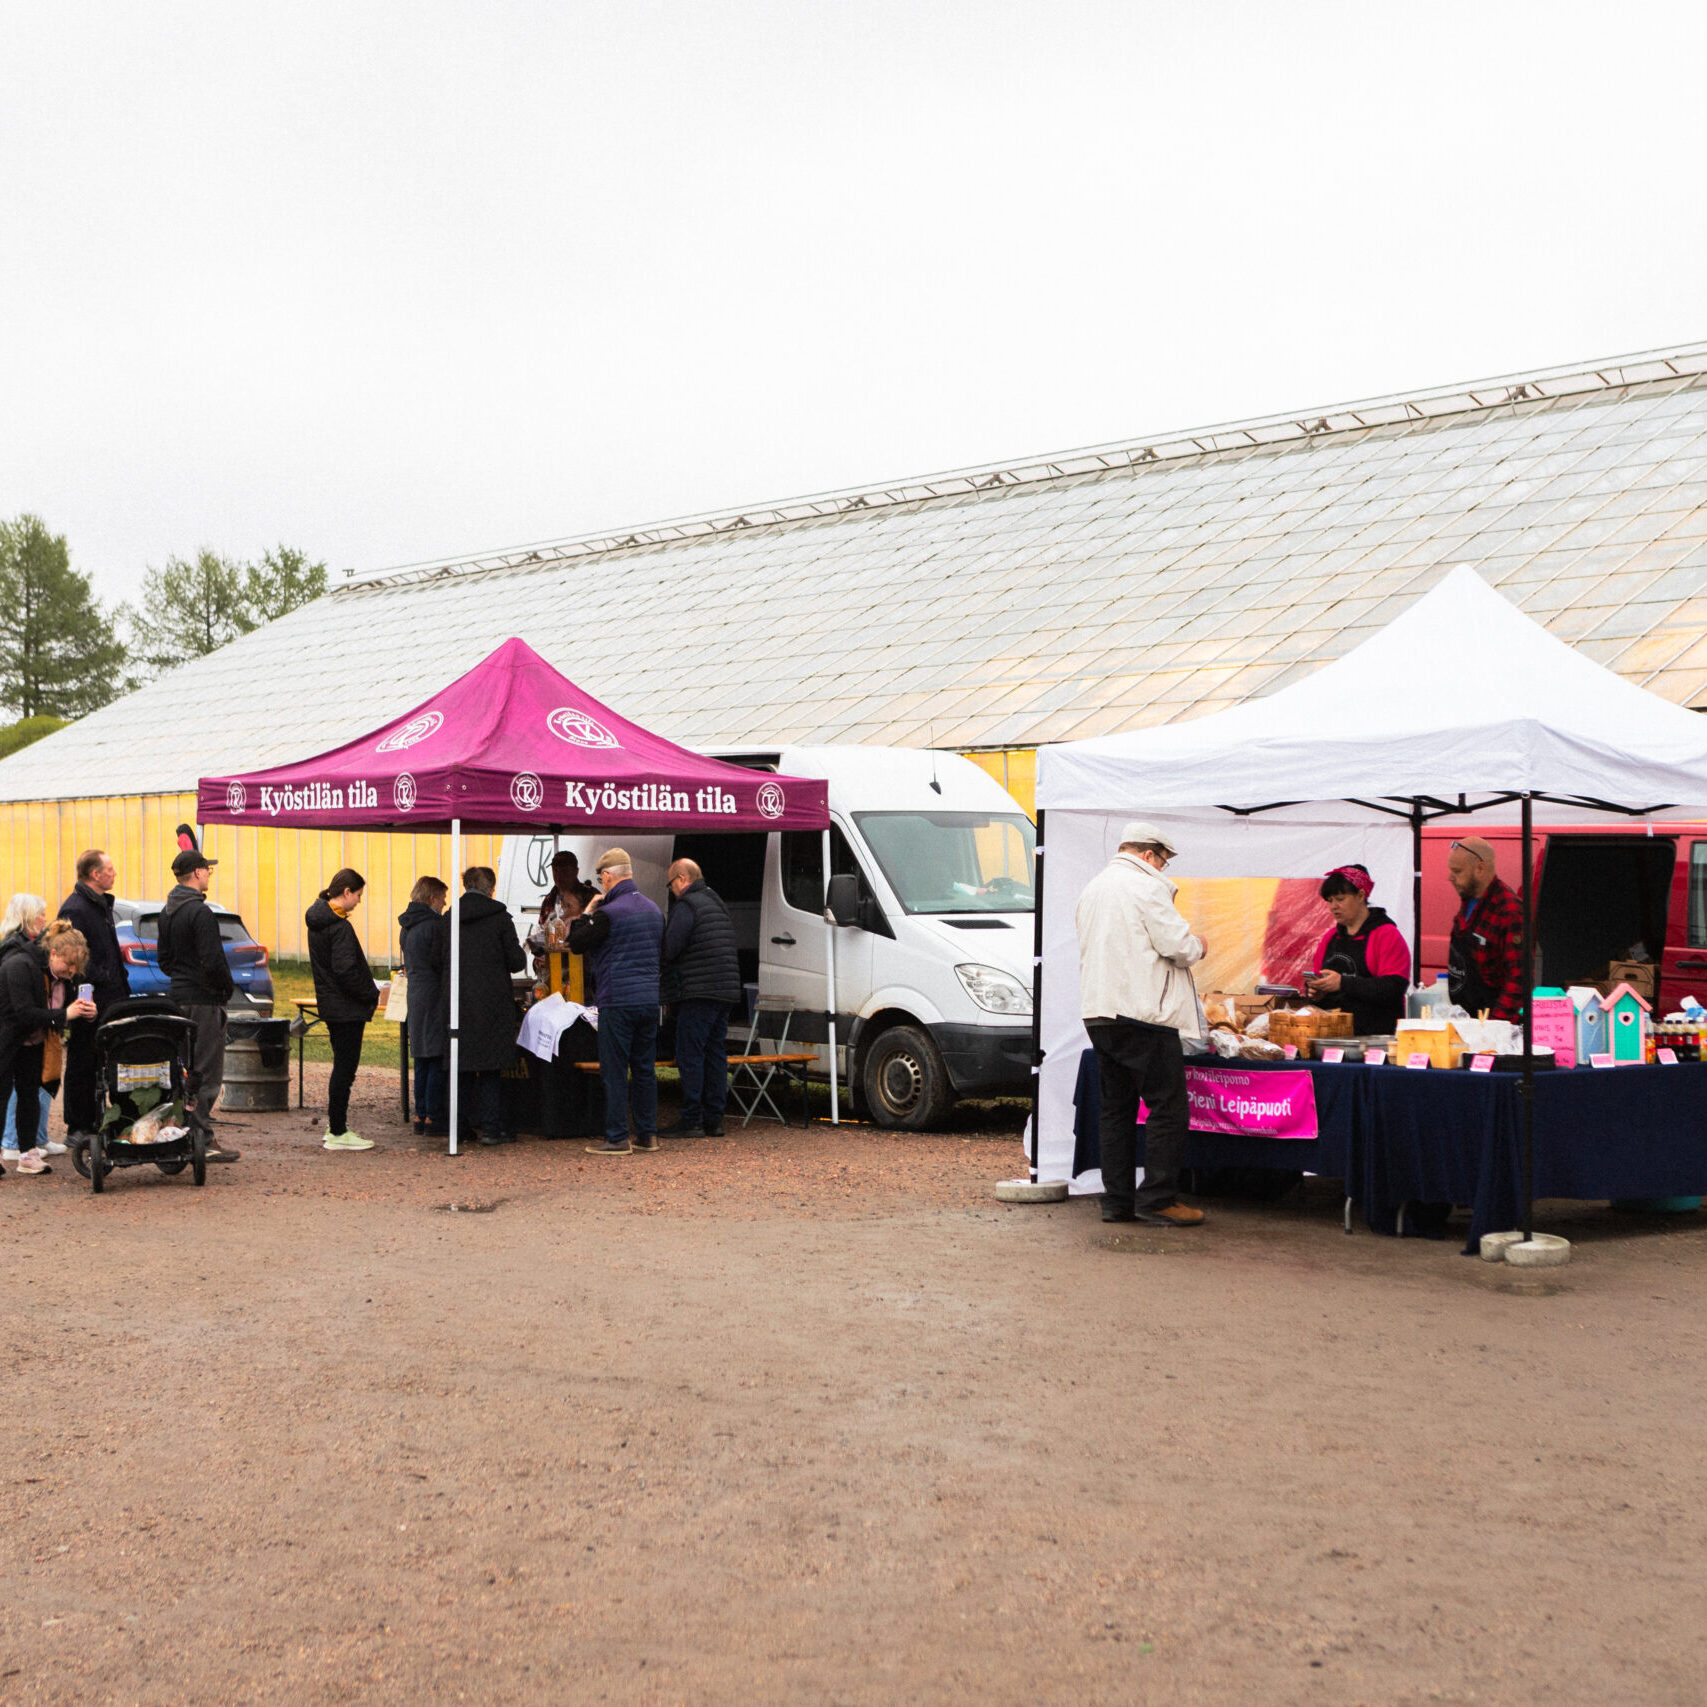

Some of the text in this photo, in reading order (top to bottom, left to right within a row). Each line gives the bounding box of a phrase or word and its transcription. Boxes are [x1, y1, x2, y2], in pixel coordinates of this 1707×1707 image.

[260, 782, 344, 816] Kyöstilän
[348, 780, 378, 808] tila
[565, 781, 738, 815] Kyöstilän tila
[1192, 1068, 1250, 1088] kotileipomo
[1220, 1095, 1292, 1121] Leipäpuoti
